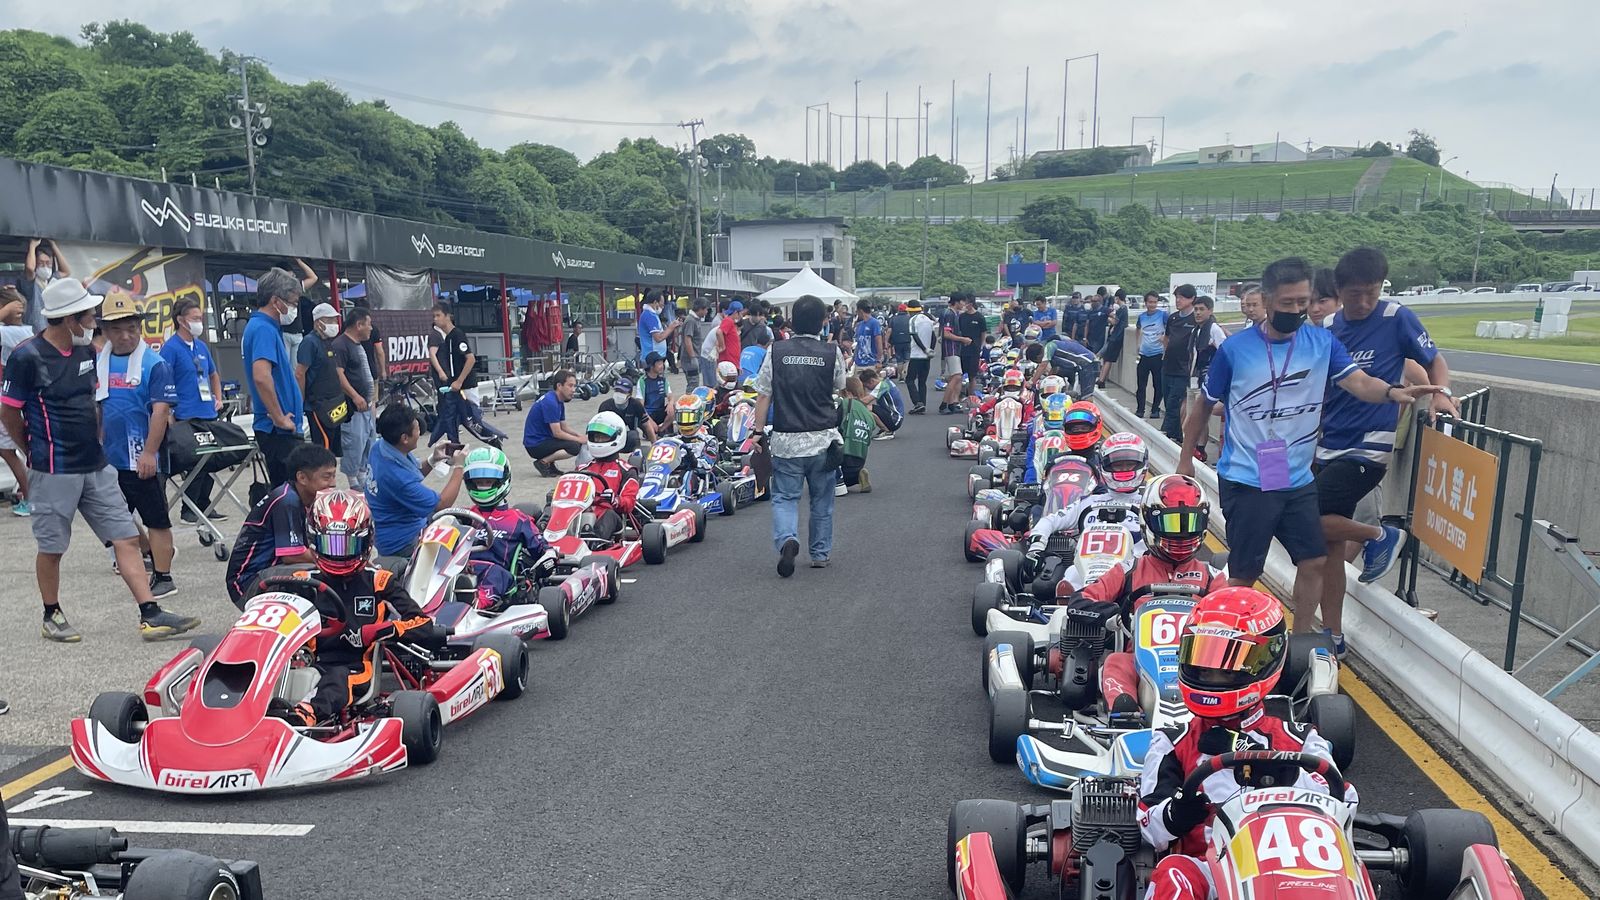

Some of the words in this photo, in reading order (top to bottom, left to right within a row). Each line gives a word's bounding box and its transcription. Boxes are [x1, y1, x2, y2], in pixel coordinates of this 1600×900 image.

[194, 213, 245, 231] SUZUKA
[247, 219, 287, 235] CIRCUIT
[437, 243, 463, 256] SUZUKA
[463, 246, 485, 257] CIRCUIT
[388, 335, 430, 362] ROTAX
[782, 355, 826, 367] OFFICIAL
[1044, 437, 1062, 448] 70
[652, 446, 674, 460] 92
[1057, 472, 1081, 483] 96
[1424, 453, 1477, 520] 立入禁止
[560, 481, 583, 499] 31
[423, 525, 457, 543] 87
[1427, 508, 1436, 529] DO
[1435, 513, 1448, 538] NOT
[1447, 522, 1467, 552] ENTER
[1086, 532, 1123, 554] 67
[234, 605, 287, 627] 58
[1196, 628, 1237, 639] birelART
[480, 655, 502, 699] 58
[450, 681, 484, 717] birelART
[1202, 697, 1218, 705] TIM
[164, 772, 253, 789] birelART
[1244, 791, 1334, 807] birelART
[1257, 816, 1343, 871] 48
[1279, 880, 1337, 891] FREELINE
